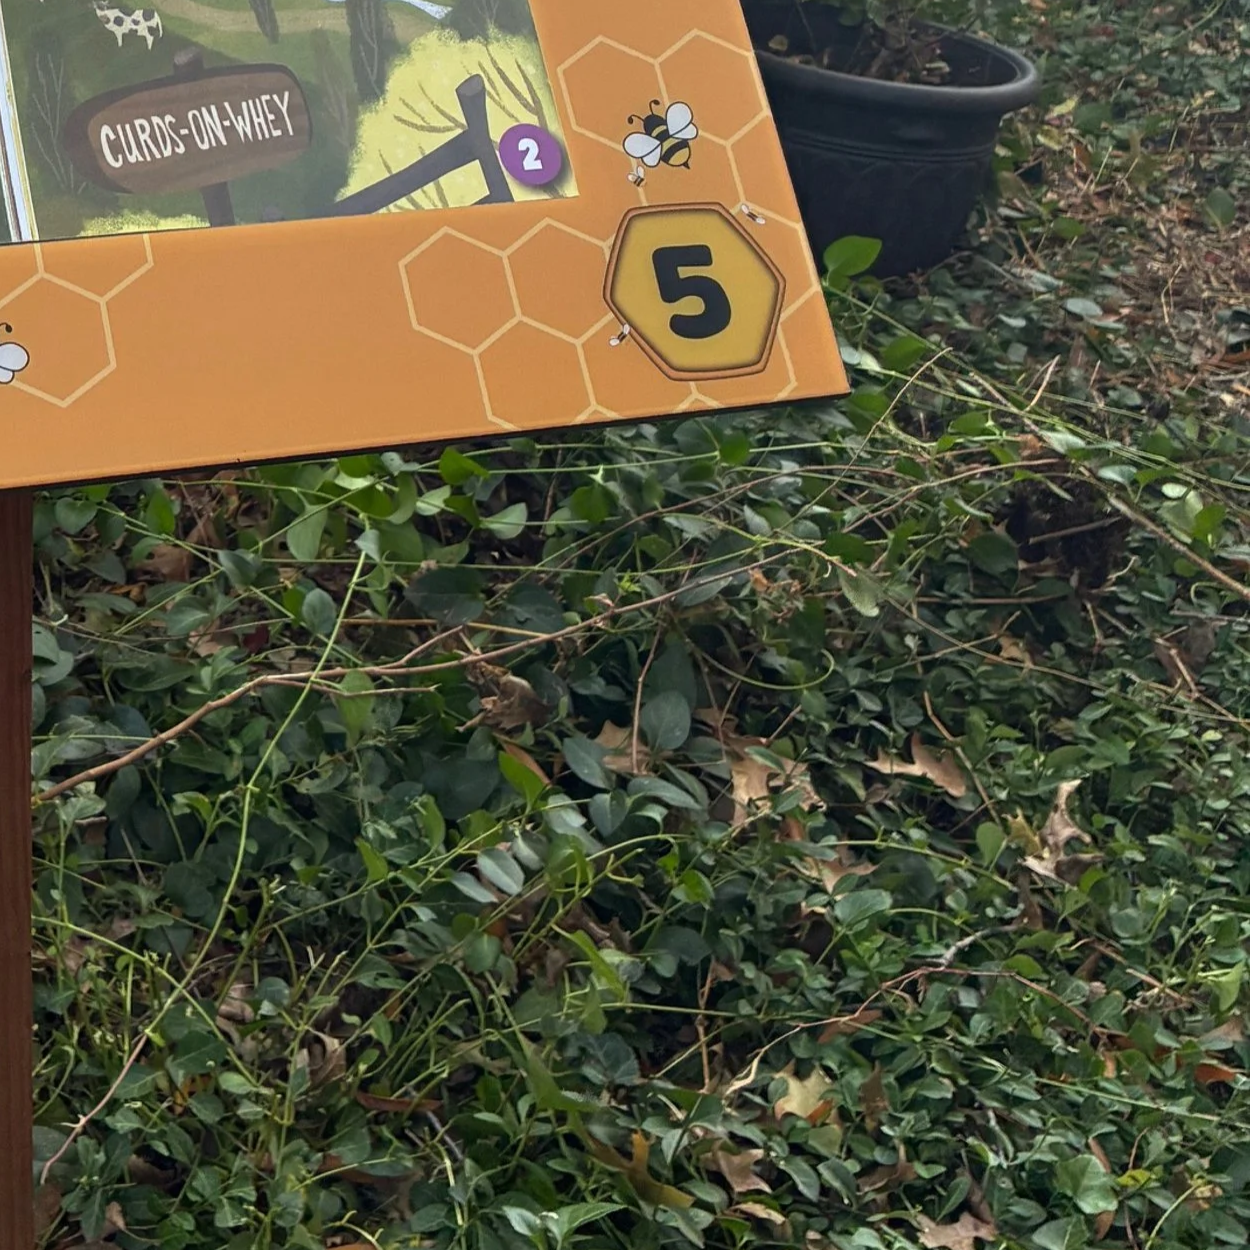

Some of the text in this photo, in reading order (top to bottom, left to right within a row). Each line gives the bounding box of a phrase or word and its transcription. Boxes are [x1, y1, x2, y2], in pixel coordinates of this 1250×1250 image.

[99, 89, 299, 169] CURDS-ON-WHEY
[517, 137, 544, 171] 2
[651, 244, 732, 339] 5
